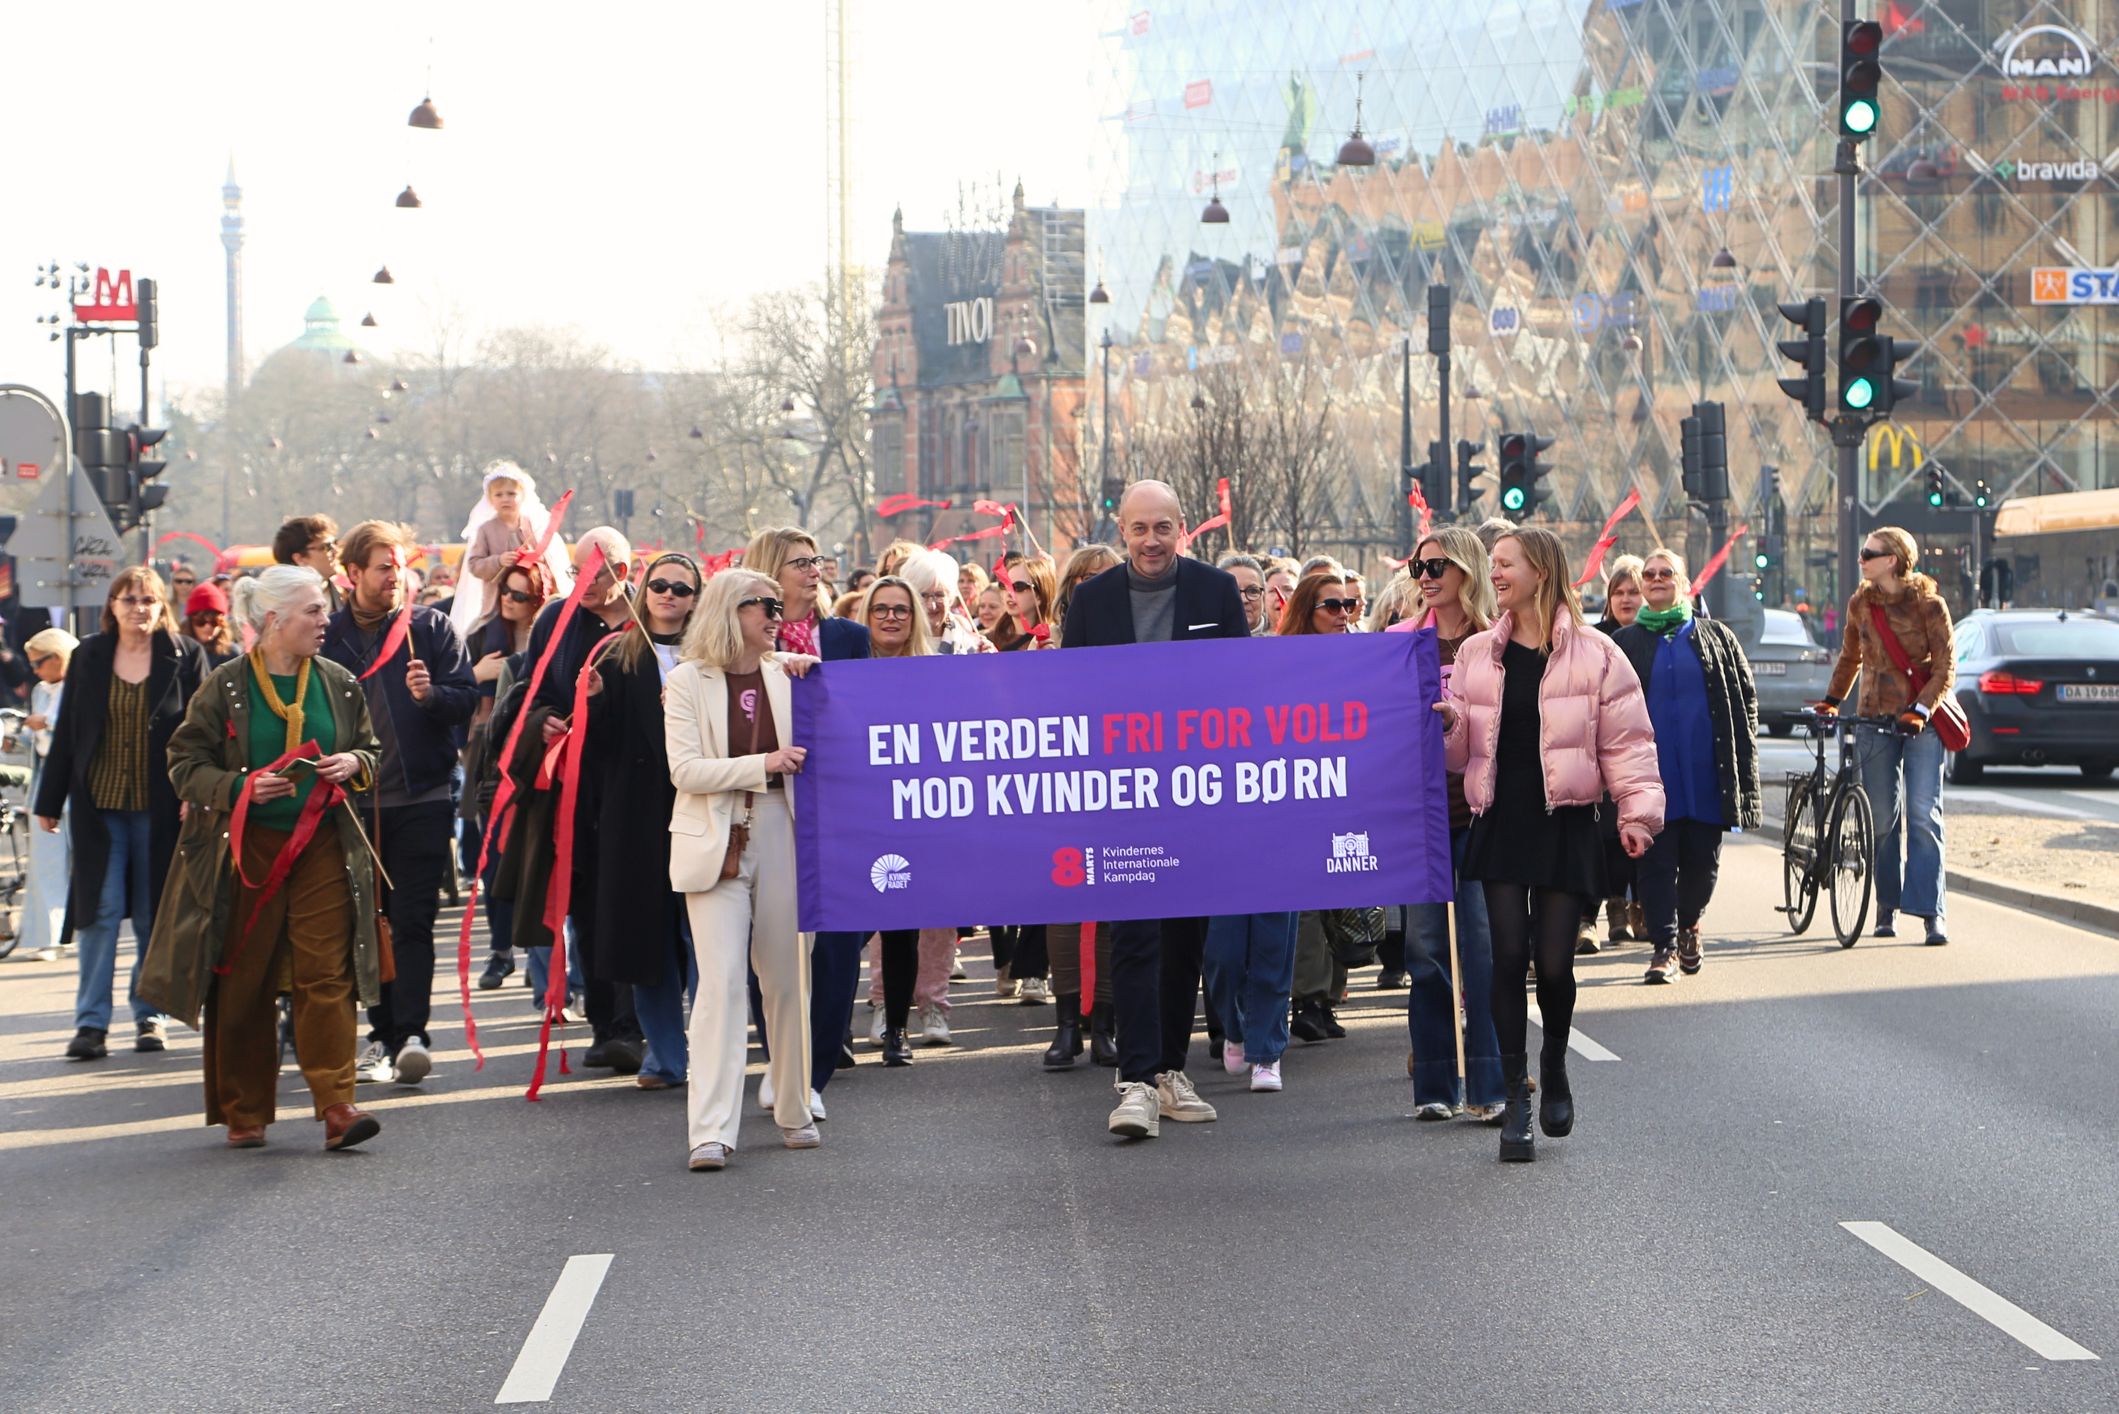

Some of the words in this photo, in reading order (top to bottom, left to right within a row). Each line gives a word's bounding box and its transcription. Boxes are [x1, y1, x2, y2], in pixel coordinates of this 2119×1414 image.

[2009, 58, 2085, 76] MAN
[2017, 158, 2098, 180] bravida
[869, 723, 920, 765] EN
[931, 715, 1089, 762] VERDEN
[1103, 711, 1163, 754] FRI
[1177, 707, 1252, 751] FOR
[1264, 701, 1369, 745] VOLD
[892, 776, 974, 820] MOD
[986, 767, 1160, 816] KVINDER
[1171, 763, 1222, 807] OG
[1235, 756, 1347, 804] BØRN
[1102, 846, 1164, 857] Kvindernes
[1051, 846, 1085, 887] 8
[1085, 847, 1095, 885] MARTS
[1103, 856, 1180, 870] Internationale
[1326, 855, 1379, 873] DANNER
[1104, 871, 1156, 883] Kampdag
